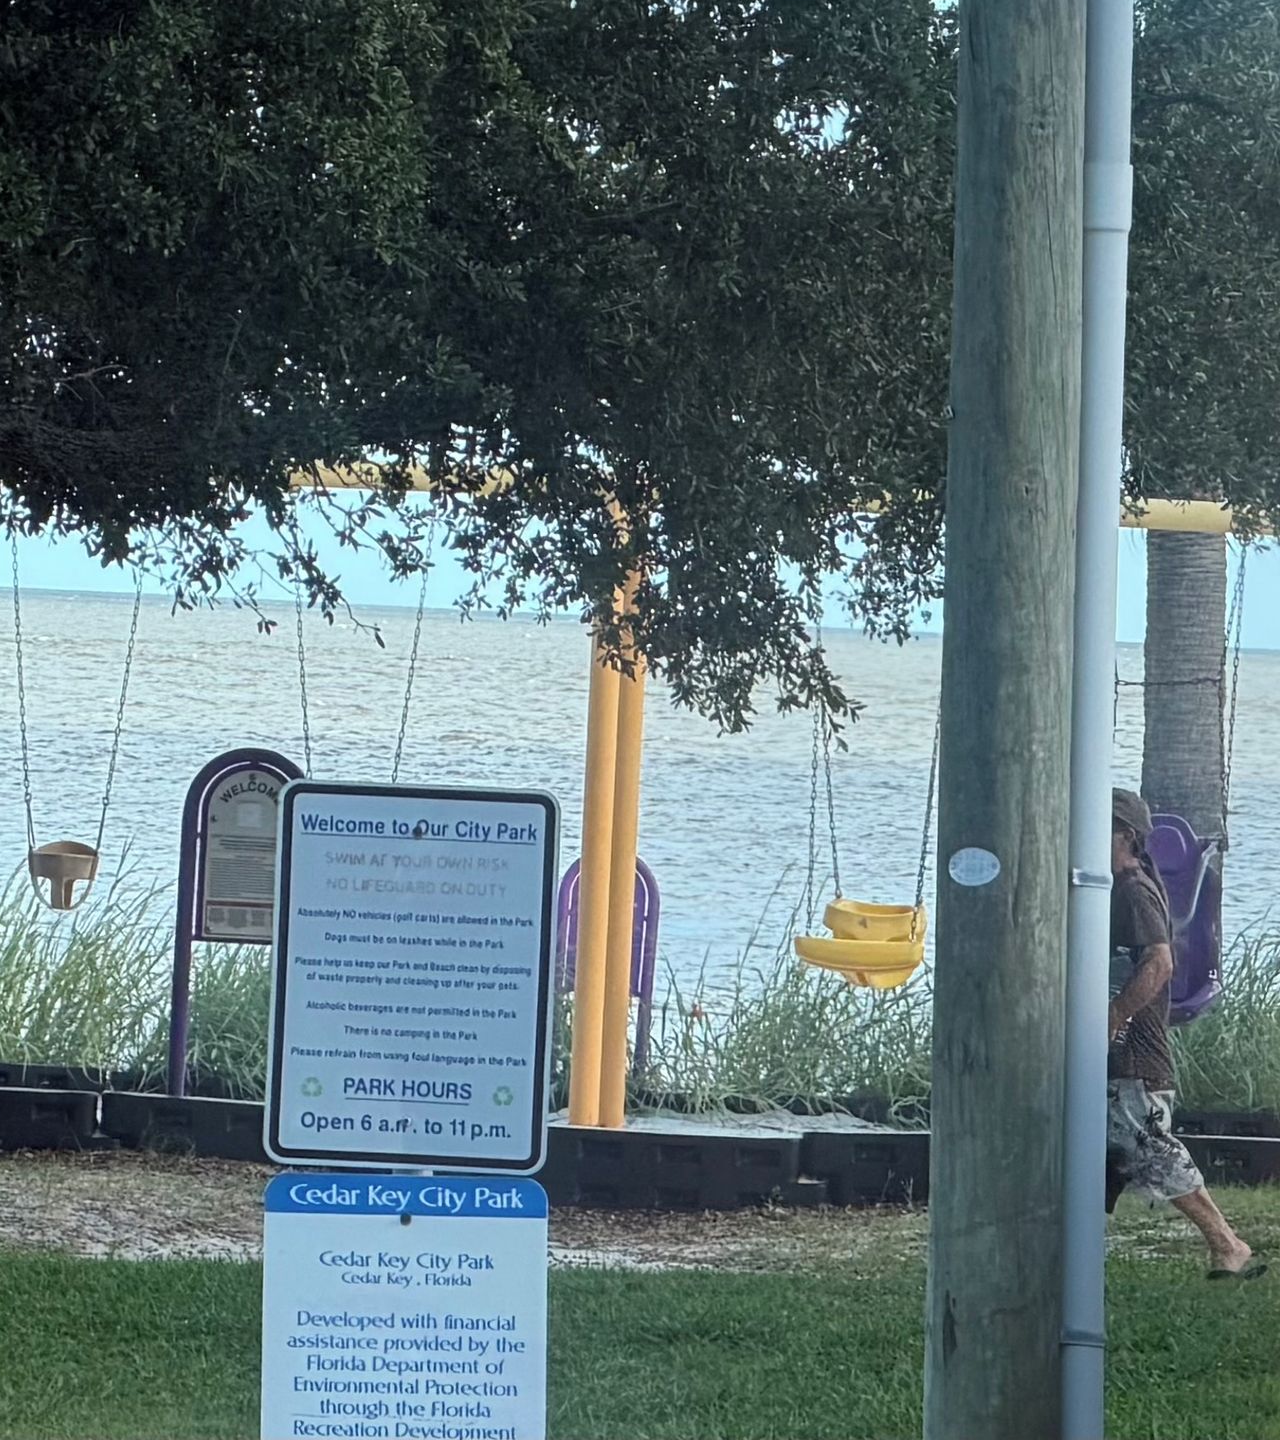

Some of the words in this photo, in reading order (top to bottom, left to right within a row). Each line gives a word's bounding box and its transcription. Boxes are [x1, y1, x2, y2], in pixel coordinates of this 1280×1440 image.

[219, 781, 278, 806] WELCOM
[301, 814, 384, 834] Welcome
[393, 819, 409, 835] to
[416, 819, 448, 838] Our
[456, 820, 491, 842] City
[497, 824, 537, 841] Park
[325, 852, 366, 866] SWIM
[370, 855, 385, 867] AT
[392, 855, 432, 869] YOUR
[437, 856, 471, 871] OWN
[477, 857, 509, 872] RISK
[327, 878, 348, 890] NO
[352, 879, 435, 894] LIFEGUARD
[440, 882, 462, 895] ON
[465, 882, 506, 897] DUTY
[298, 908, 340, 921] Absolutely
[343, 910, 356, 919] NO
[358, 911, 391, 921] vehicles
[393, 912, 413, 923] (golf
[415, 913, 440, 924] carts)
[442, 916, 455, 924] are
[457, 915, 488, 925] allowed
[490, 917, 498, 925] in
[500, 917, 513, 926] the
[515, 917, 533, 927] Park
[325, 932, 347, 943] Dogs
[349, 933, 370, 943] must
[372, 935, 384, 944] be
[399, 936, 432, 946] leashes
[434, 937, 457, 947] while
[459, 939, 467, 948] in
[469, 939, 483, 948] the
[485, 940, 504, 949] Park
[294, 956, 321, 966] Please
[324, 958, 341, 968] help
[343, 960, 353, 968] us
[355, 960, 374, 970] keep
[392, 961, 411, 970] Park
[413, 963, 428, 971] and
[430, 962, 455, 972] Beach
[457, 964, 479, 973] clean
[480, 965, 490, 975] by
[493, 965, 532, 977] disposing
[306, 972, 316, 981] of
[318, 973, 343, 982] waste
[345, 974, 382, 985] properly
[385, 975, 401, 984] and
[403, 976, 439, 988] cleaning
[441, 979, 452, 988] up
[454, 978, 474, 988] after
[477, 981, 496, 990] your
[306, 1001, 346, 1011] Alcoholic
[348, 1002, 393, 1014] beverages
[396, 1006, 409, 1014] are
[411, 1006, 426, 1015] not
[428, 1006, 470, 1017] permitted
[472, 1008, 480, 1017] in
[482, 1009, 495, 1018] the
[498, 1009, 517, 1019] Park
[344, 1025, 369, 1035] There
[371, 1027, 379, 1036] is
[381, 1028, 392, 1036] no
[395, 1029, 431, 1040] camping
[433, 1029, 440, 1039] in
[442, 1030, 456, 1040] the
[458, 1031, 477, 1040] Park
[290, 1047, 322, 1057] Please
[324, 1048, 356, 1059] refrain
[360, 1049, 382, 1060] from
[384, 1052, 409, 1062] using
[412, 1052, 430, 1062] foul
[432, 1053, 476, 1066] language
[478, 1055, 486, 1064] in
[489, 1056, 504, 1066] the
[506, 1057, 527, 1067] Park
[344, 1077, 395, 1096] PARK
[402, 1080, 472, 1100] HOURS
[301, 1111, 354, 1132] Open
[361, 1114, 372, 1131] 6
[425, 1118, 442, 1135] to
[450, 1118, 466, 1136] 11
[471, 1122, 511, 1141] p.m.
[290, 1183, 361, 1206] Cedar
[368, 1185, 411, 1212] Key
[419, 1186, 467, 1213] City
[475, 1187, 524, 1209] Park
[319, 1250, 371, 1268] Cedar
[378, 1252, 410, 1272] Key
[416, 1253, 451, 1273] City
[458, 1254, 494, 1270] Park
[341, 1272, 381, 1285] Cedar
[425, 1273, 472, 1287] Florida
[297, 1311, 395, 1331] Developed
[401, 1313, 437, 1329] with
[444, 1315, 516, 1331] financial
[287, 1335, 378, 1350] assistance
[384, 1336, 462, 1352] provided
[469, 1336, 490, 1356] by
[496, 1338, 525, 1353] the
[307, 1355, 366, 1372] Florida
[372, 1356, 479, 1377] Department
[485, 1358, 505, 1375] of
[293, 1377, 419, 1395] Environmental
[425, 1379, 518, 1397] Protection
[320, 1399, 389, 1419] through
[395, 1400, 425, 1418] the
[431, 1402, 491, 1418] Florida
[293, 1420, 388, 1437] Recreation
[395, 1421, 516, 1440] Development
